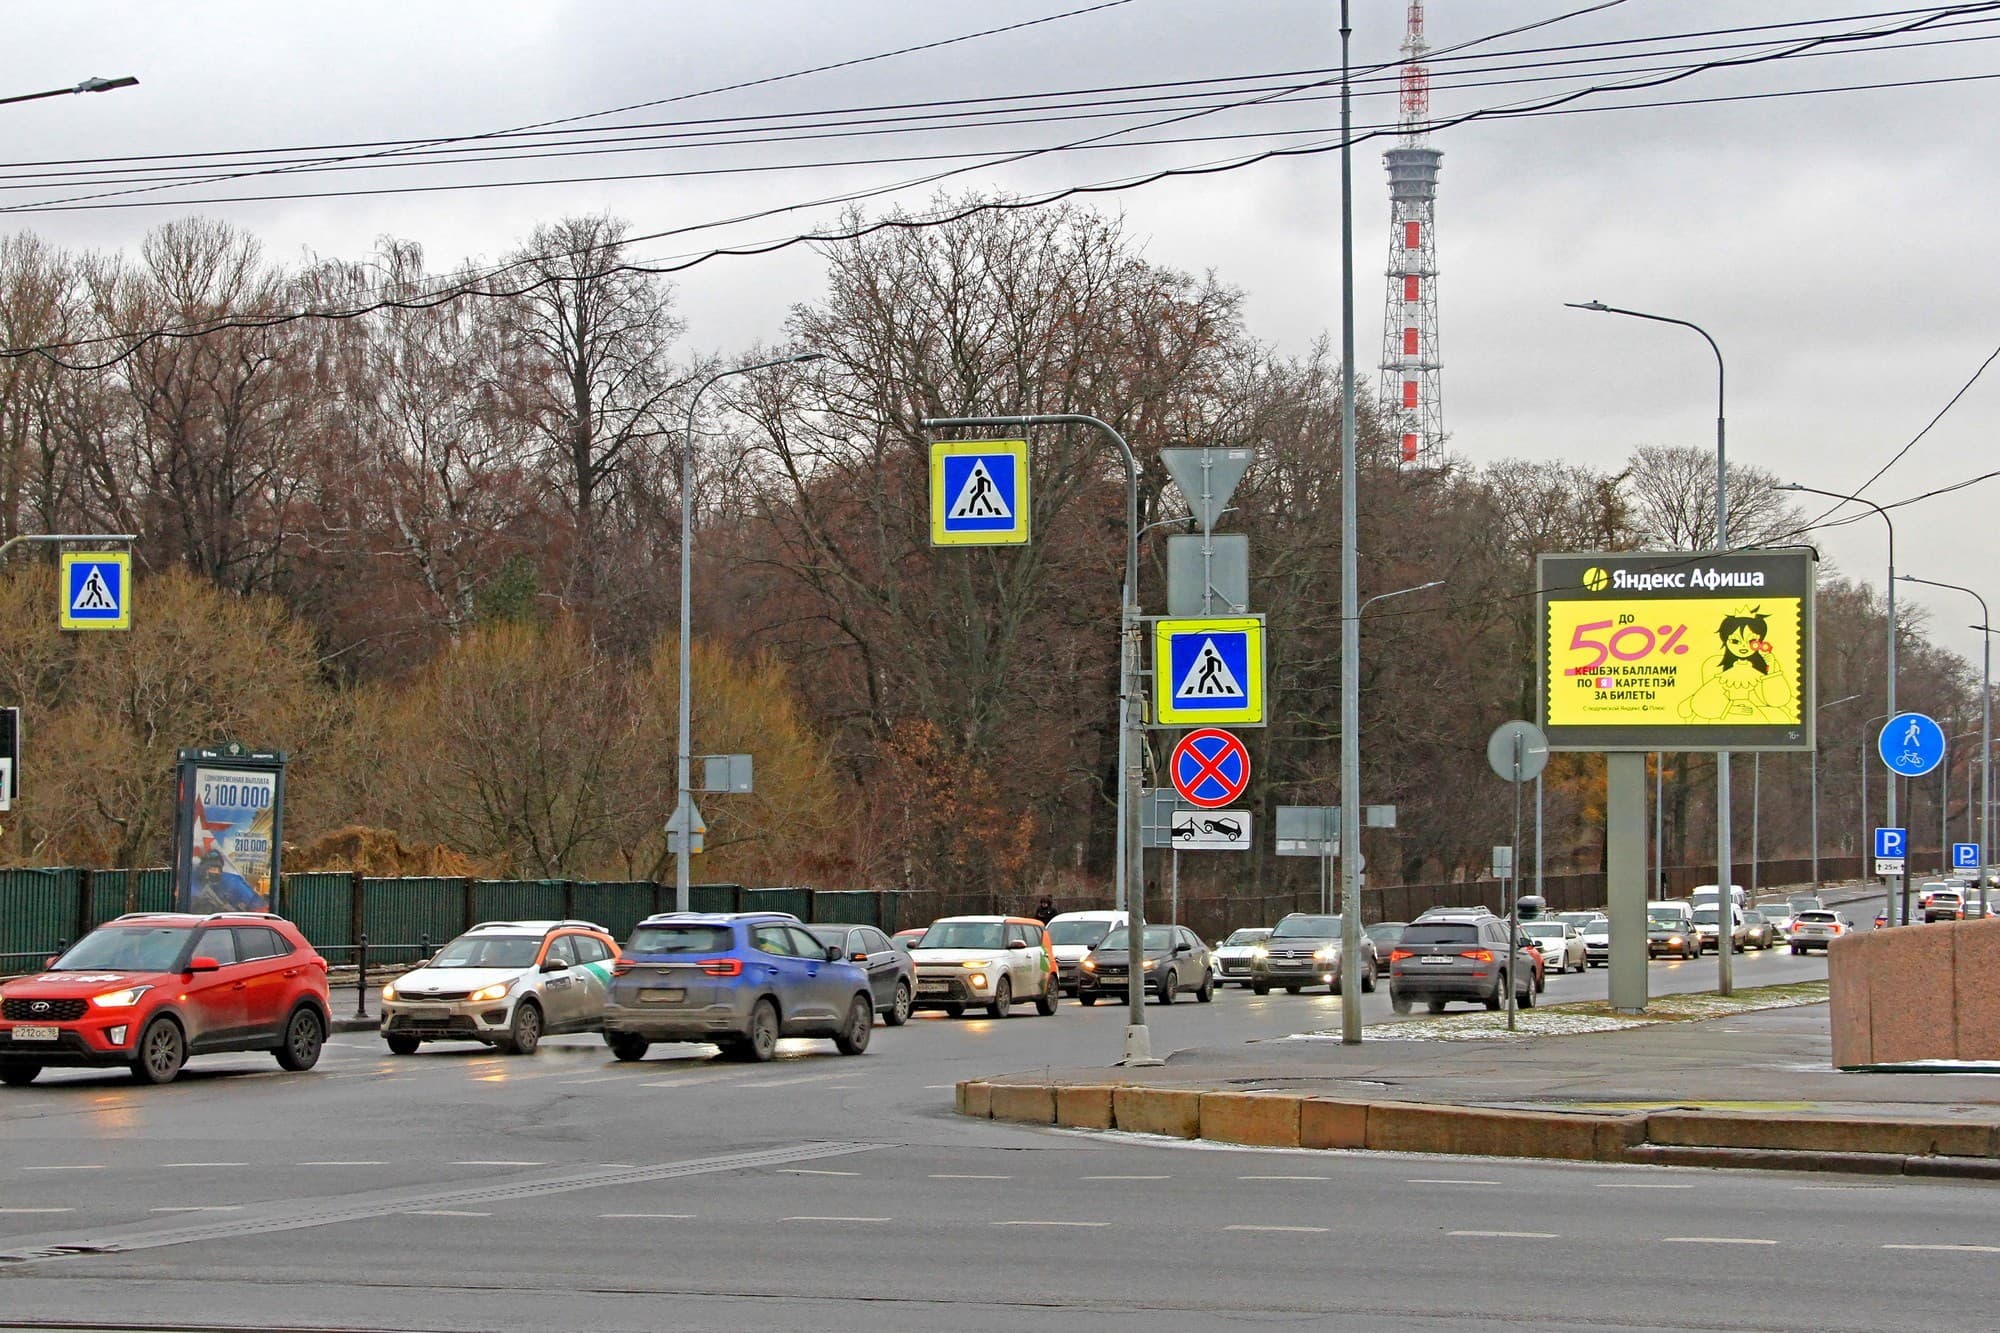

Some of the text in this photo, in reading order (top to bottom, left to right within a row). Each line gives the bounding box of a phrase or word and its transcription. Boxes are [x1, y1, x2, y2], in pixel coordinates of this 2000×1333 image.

[1613, 568, 1765, 590] Яндекс Афиша
[1618, 614, 1635, 625] ДО
[1564, 620, 1689, 677] 50%
[1574, 666, 1677, 676] КЕШБЭК БАЛЛАМИ
[1577, 678, 1592, 688] ПО
[1615, 678, 1650, 688] КАРТЕ
[1652, 676, 1675, 688] ПЭЙ
[1594, 691, 1655, 700] ЗА БИЛЕТЫ
[204, 783, 270, 808] 2 100 000
[234, 838, 267, 852] 210 000
[1883, 831, 1901, 855] P
